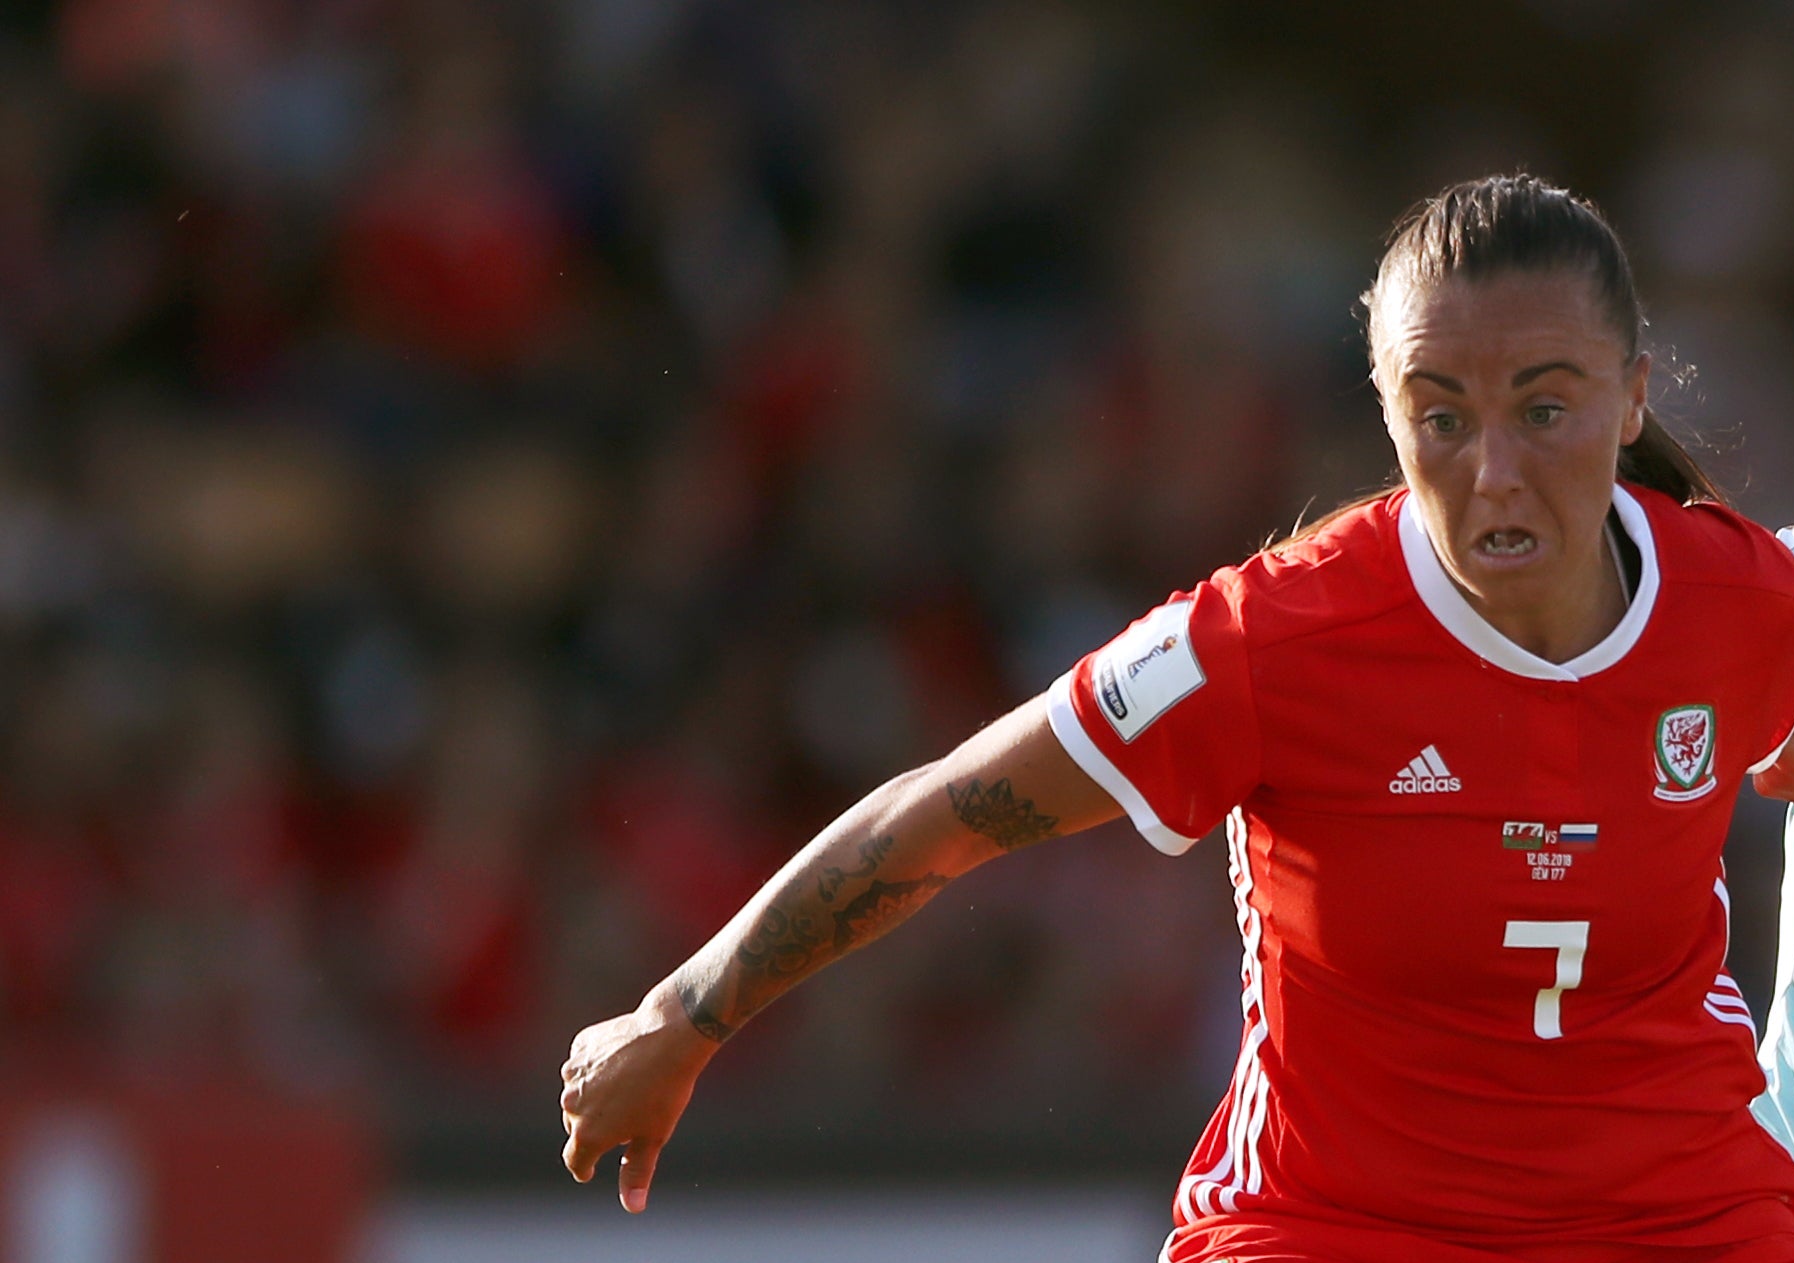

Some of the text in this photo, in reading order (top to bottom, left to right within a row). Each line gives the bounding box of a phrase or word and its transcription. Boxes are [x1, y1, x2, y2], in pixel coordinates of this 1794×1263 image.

[1389, 777, 1462, 795] adidas
[1551, 867, 1566, 881] 177
[1502, 921, 1590, 1040] 7
